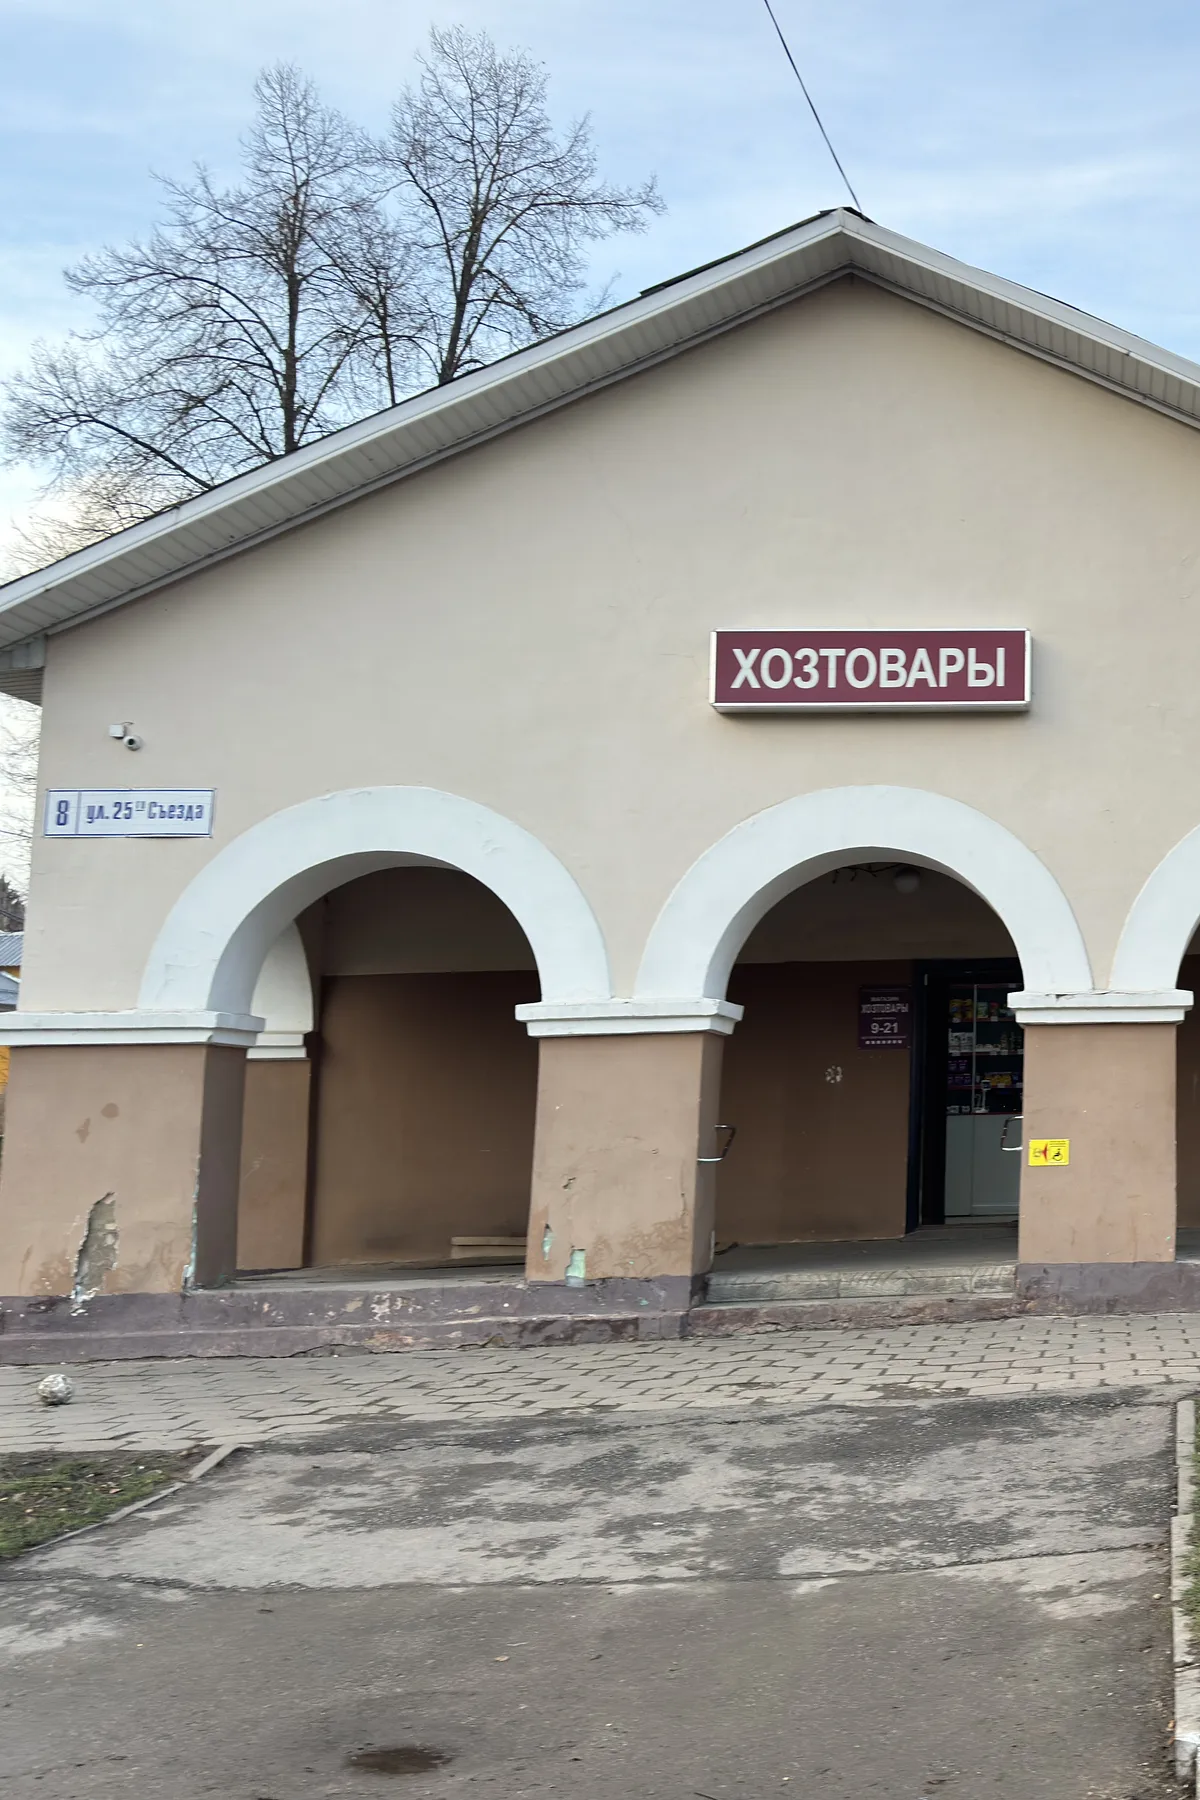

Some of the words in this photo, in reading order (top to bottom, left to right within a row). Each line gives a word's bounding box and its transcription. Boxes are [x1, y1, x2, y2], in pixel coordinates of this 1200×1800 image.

[730, 647, 1006, 689] ХОЗТОВАРЫ
[56, 799, 69, 826] 8
[86, 805, 110, 824] ул.
[147, 801, 204, 821] Съезда
[870, 1022, 899, 1034] 9-21
